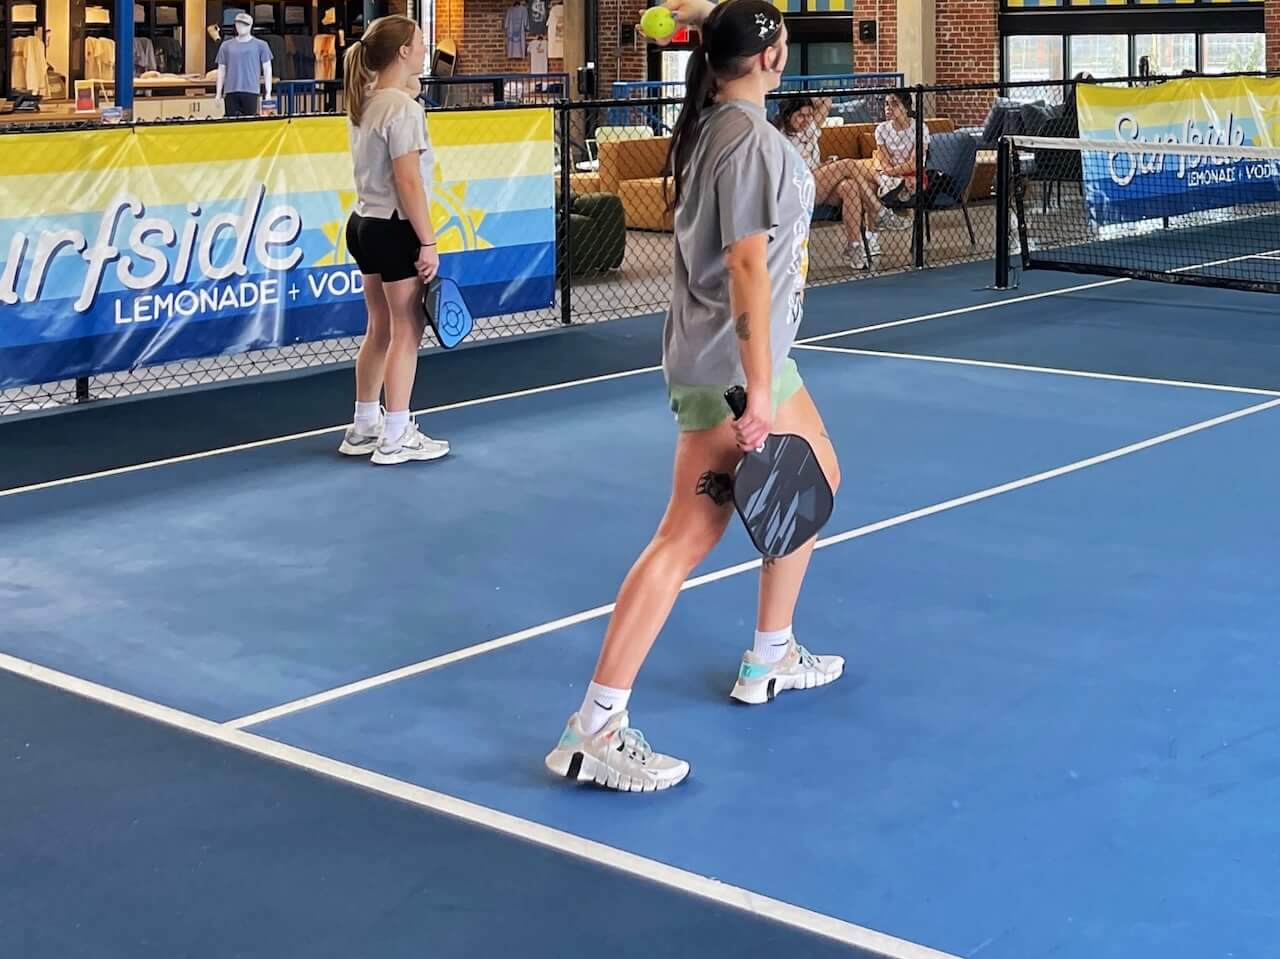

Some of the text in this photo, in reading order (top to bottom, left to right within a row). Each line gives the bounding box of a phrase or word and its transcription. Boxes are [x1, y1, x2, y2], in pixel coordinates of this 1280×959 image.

[1245, 163, 1275, 180] VOD
[0, 183, 304, 313] urfside
[115, 279, 279, 325] LEMONADE
[308, 269, 364, 298] VOD
